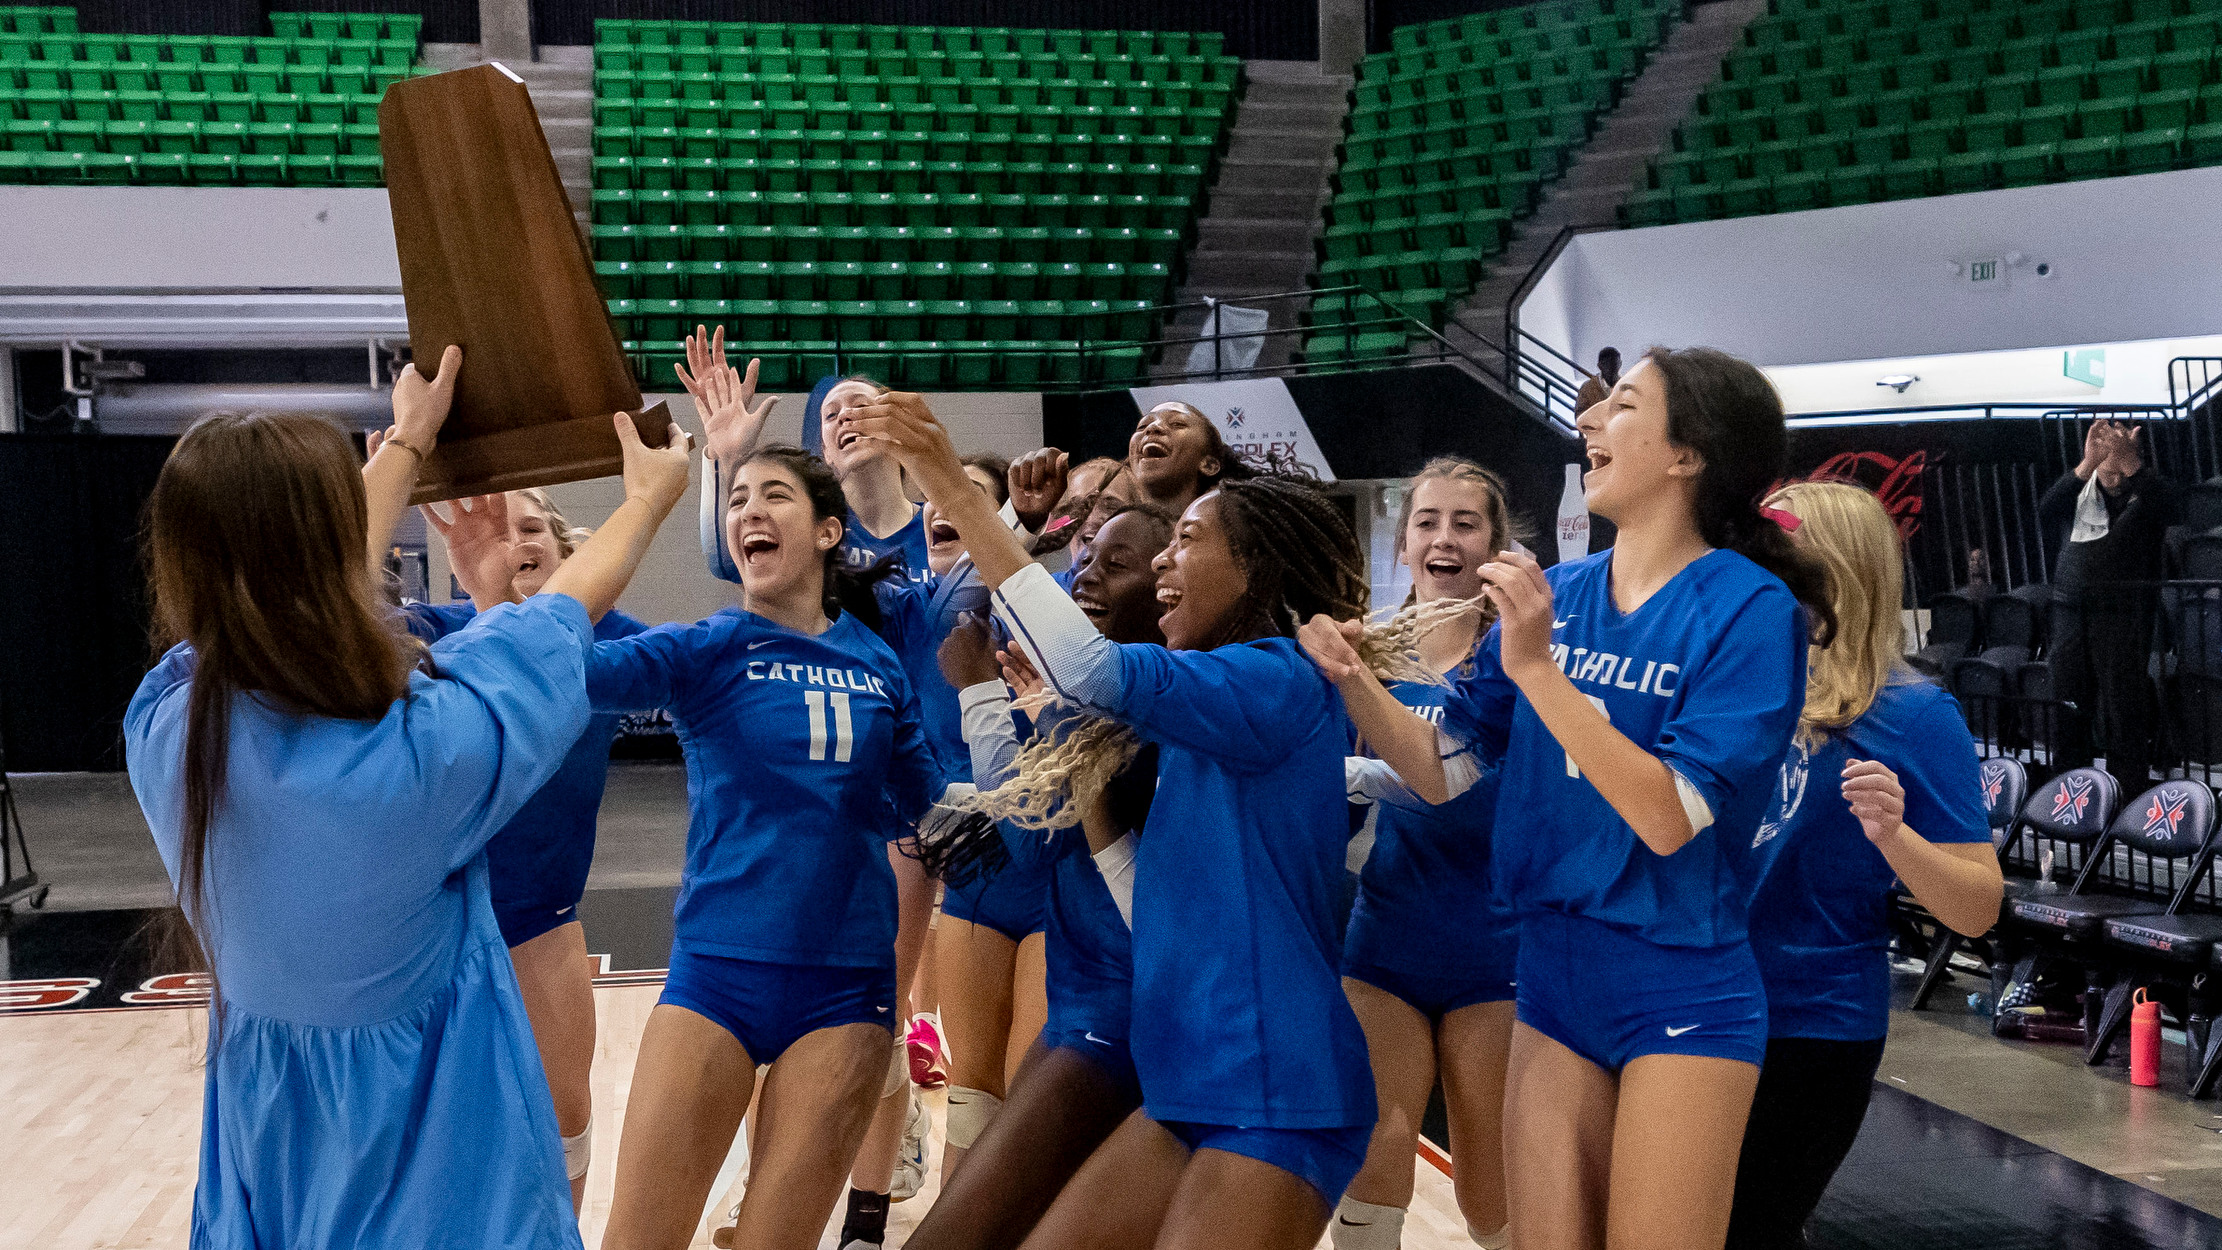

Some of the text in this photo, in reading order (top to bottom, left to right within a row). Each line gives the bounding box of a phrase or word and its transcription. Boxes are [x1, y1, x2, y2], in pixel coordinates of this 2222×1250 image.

[1971, 261, 1997, 281] EXIT
[746, 661, 889, 699] CATHOLIC
[1549, 643, 1680, 697] ATHOLIC
[804, 690, 853, 763] 11
